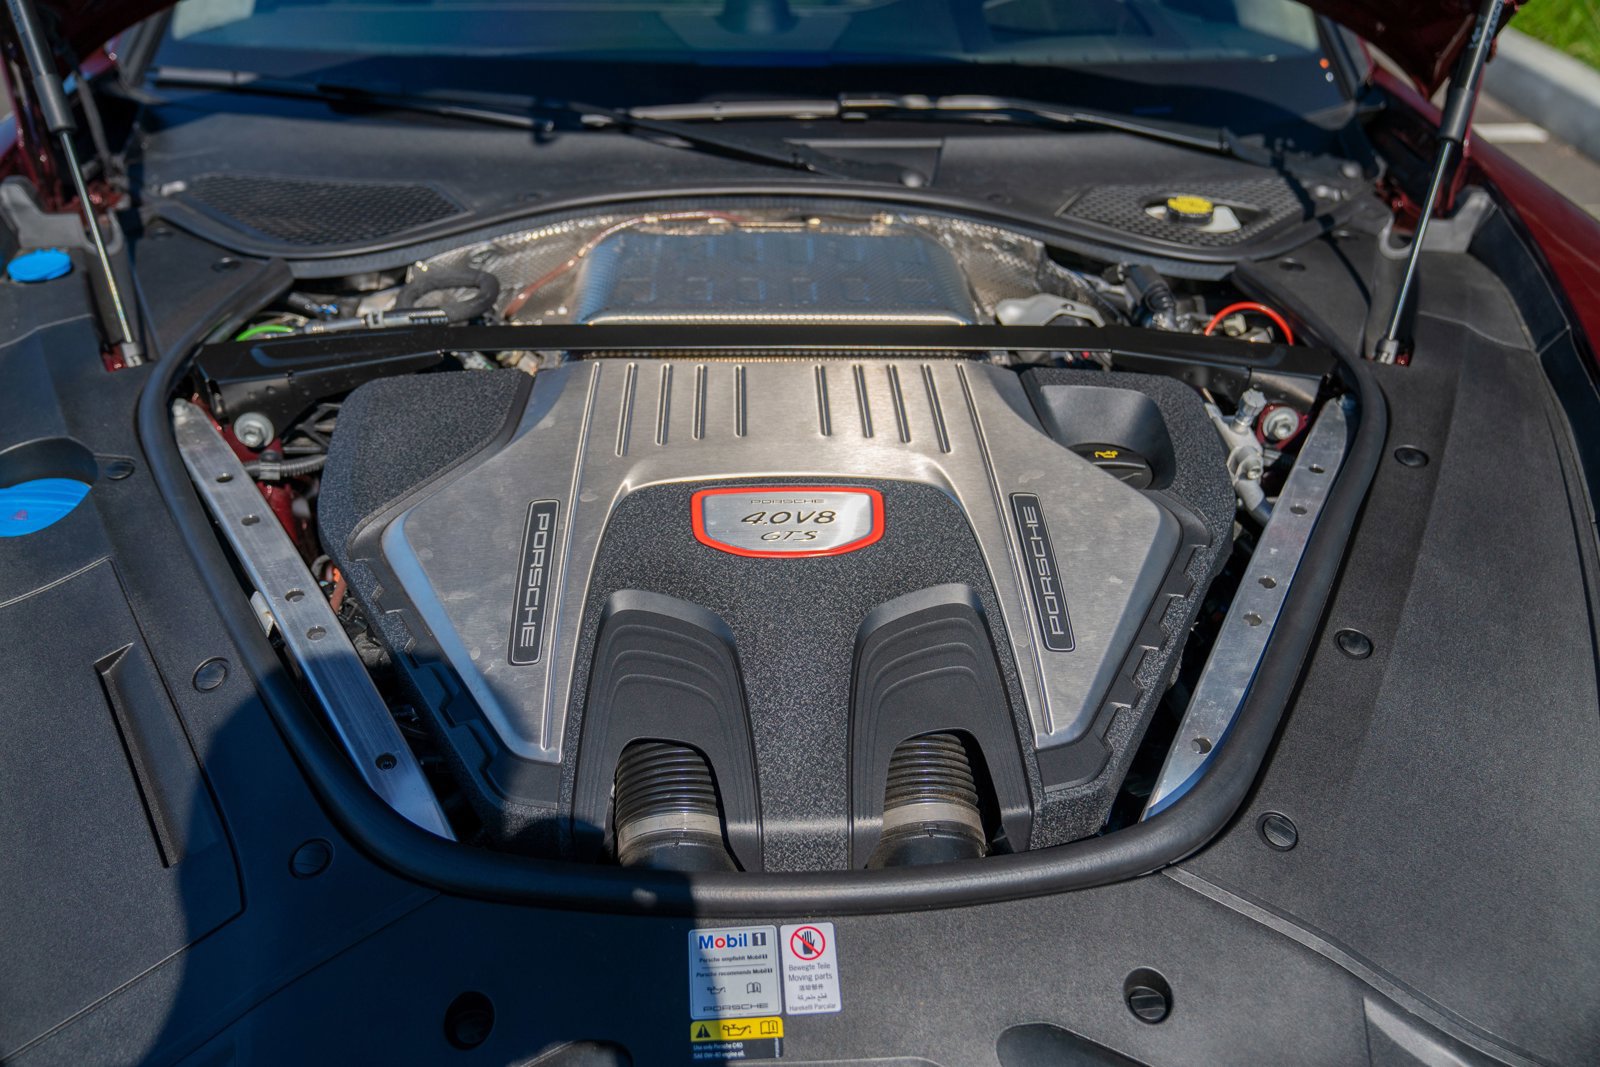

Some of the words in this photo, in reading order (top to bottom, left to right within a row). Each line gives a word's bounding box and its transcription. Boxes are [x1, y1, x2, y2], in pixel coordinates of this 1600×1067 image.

[760, 530, 818, 541] GTS
[1023, 506, 1064, 635] PORSCHE
[520, 513, 550, 647] PORSCHE
[698, 932, 748, 950] Mobil
[753, 932, 766, 947] 1
[788, 964, 816, 972] Bewegte
[817, 962, 831, 970] Teile
[788, 973, 813, 982] Moving
[814, 972, 833, 981] parts
[703, 1002, 769, 1012] PORSCHE
[713, 1042, 732, 1050] Porsche
